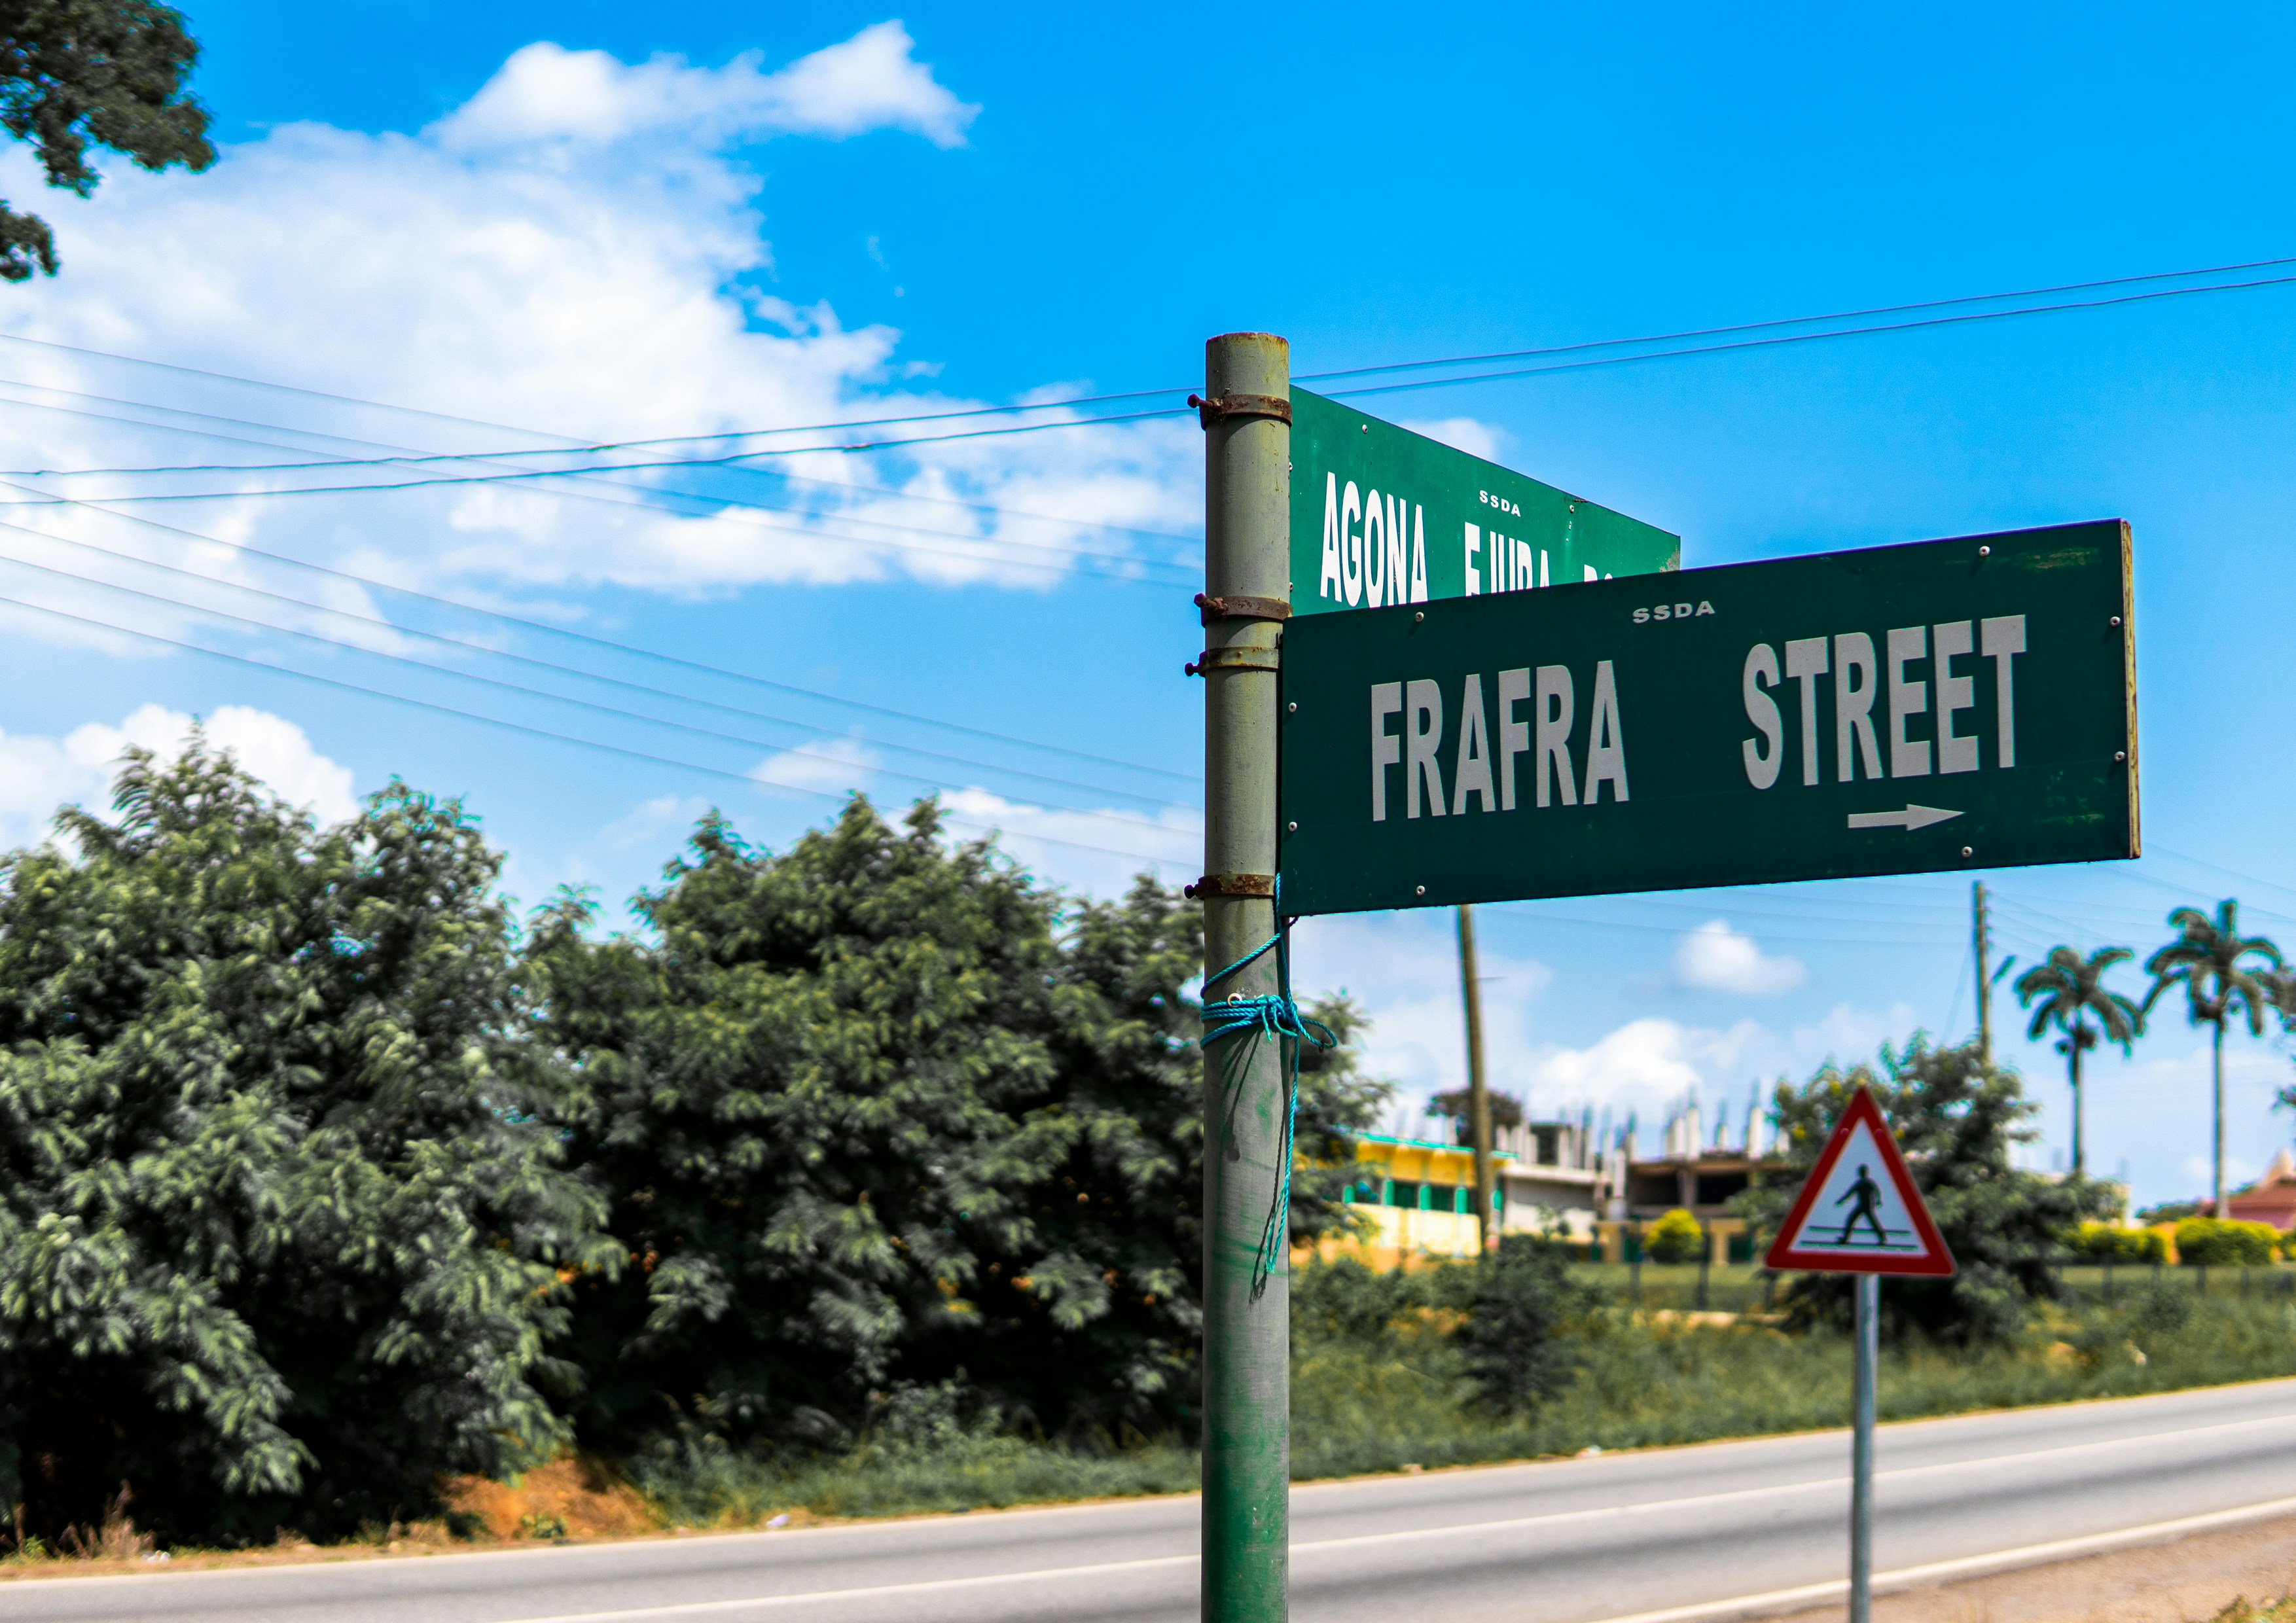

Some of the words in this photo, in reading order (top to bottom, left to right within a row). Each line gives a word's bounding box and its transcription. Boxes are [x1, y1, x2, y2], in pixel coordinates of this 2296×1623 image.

[1319, 471, 1428, 609] AGONA
[1479, 490, 1521, 518] SSDA
[1632, 601, 1715, 624] SSDA
[1371, 660, 1628, 821] FRAFRA
[1742, 615, 2026, 789] STREET
